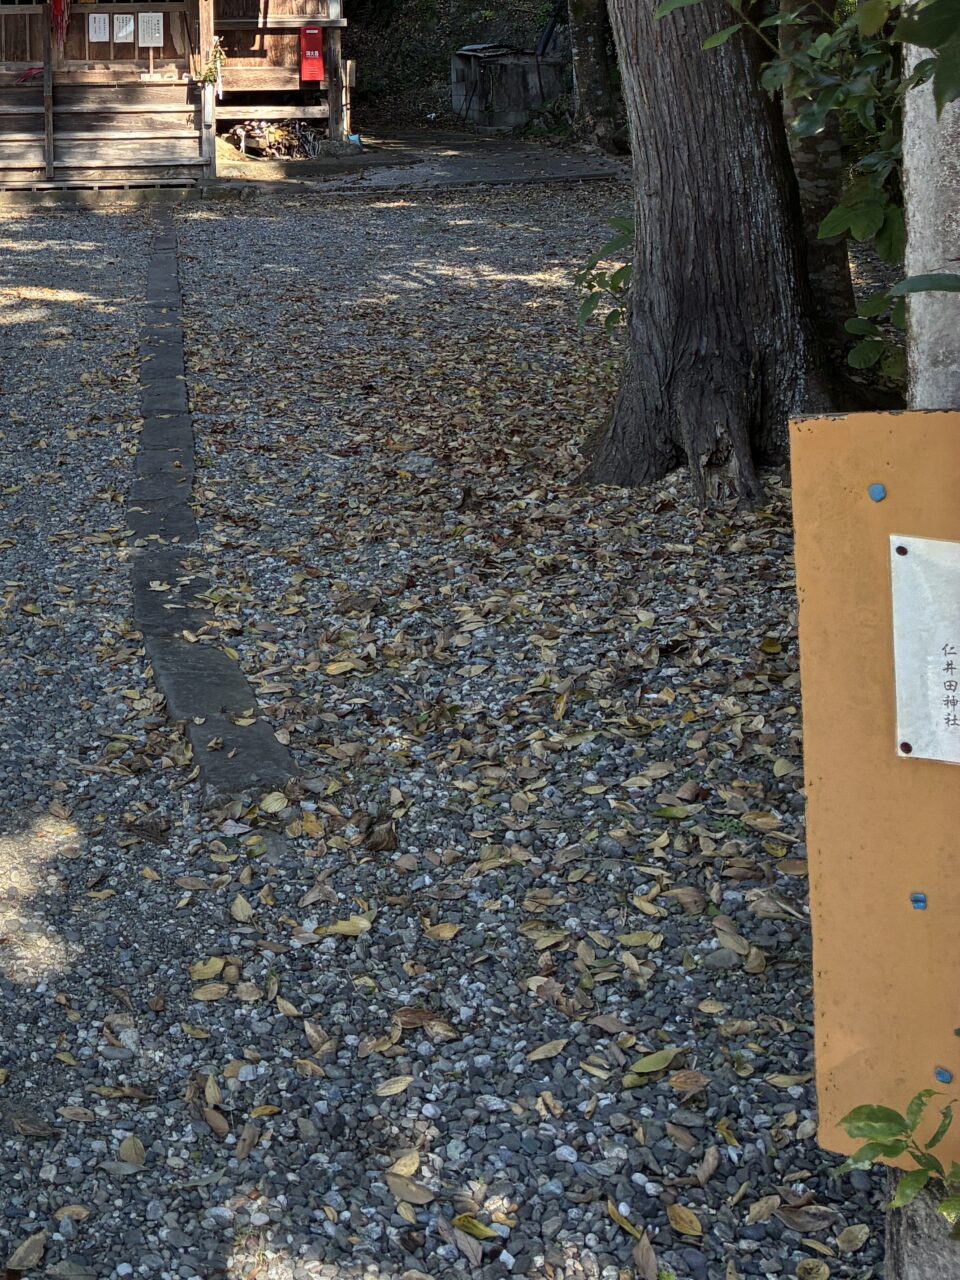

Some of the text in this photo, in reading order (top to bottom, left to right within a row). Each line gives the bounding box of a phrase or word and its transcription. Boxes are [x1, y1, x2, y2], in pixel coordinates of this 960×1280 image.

[941, 643, 960, 727] 仁井田神社
